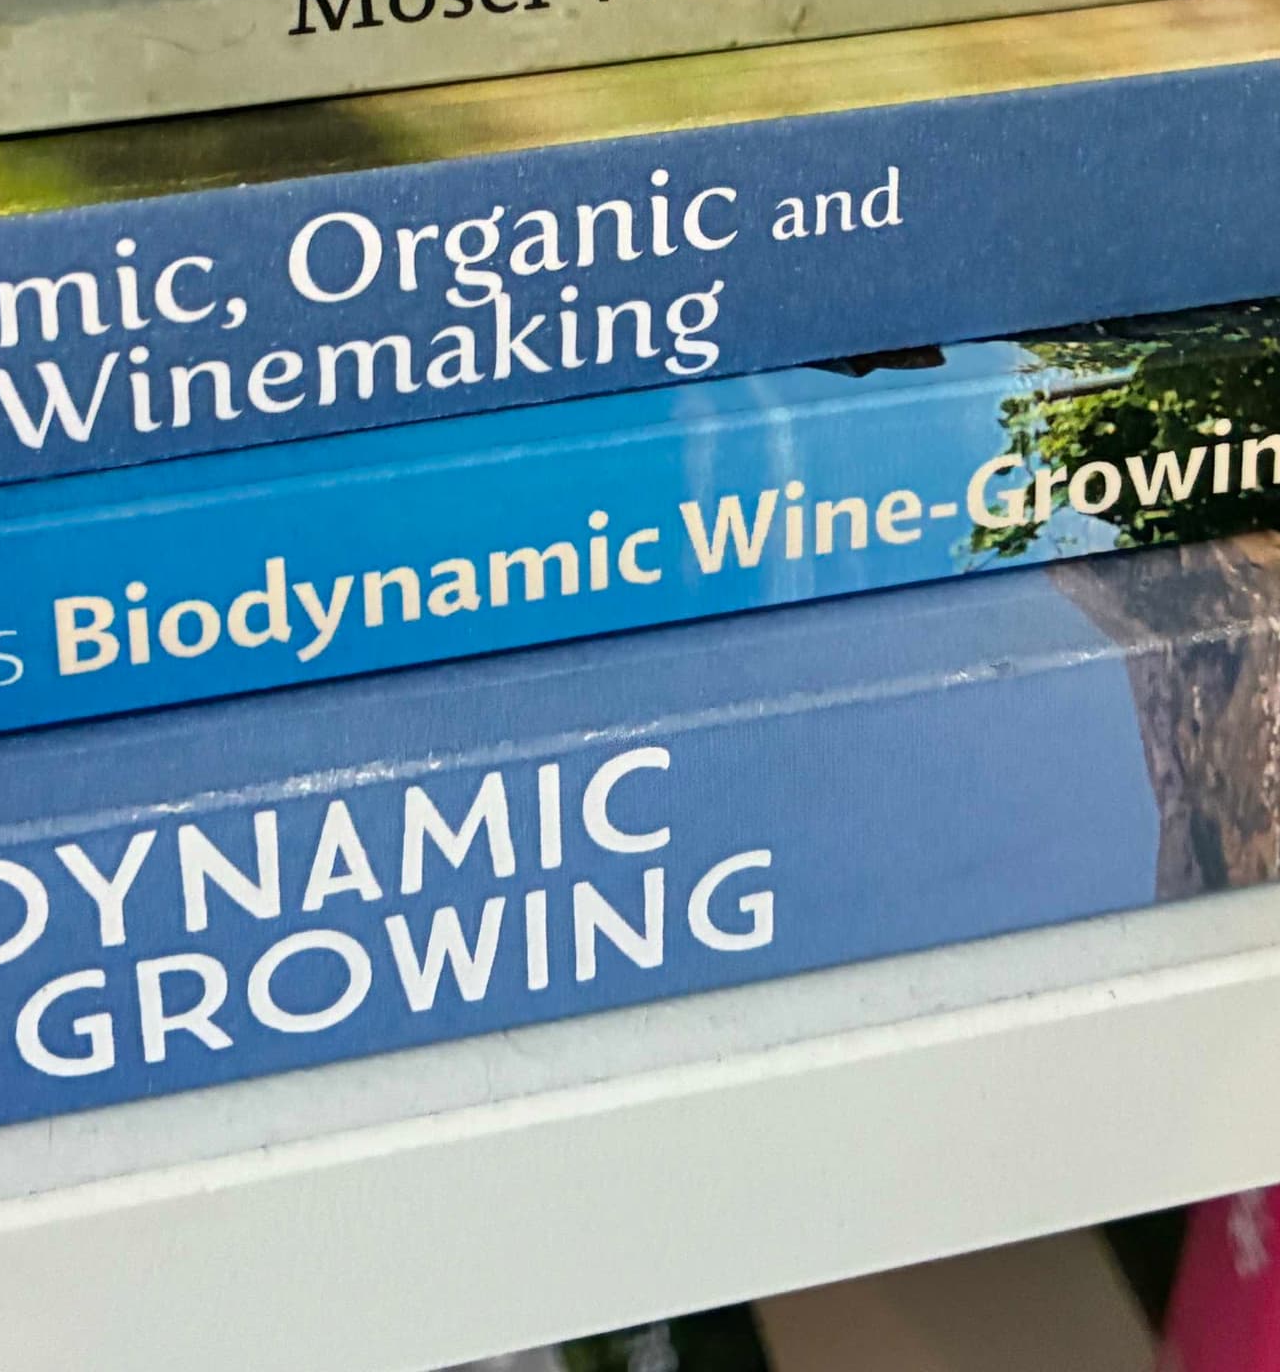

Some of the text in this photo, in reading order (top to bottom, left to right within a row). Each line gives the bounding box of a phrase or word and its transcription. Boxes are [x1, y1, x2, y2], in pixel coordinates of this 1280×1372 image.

[286, 167, 740, 310] Organic
[770, 166, 905, 244] and
[53, 509, 662, 678] Biodynamic
[14, 849, 778, 1078] GROWING
